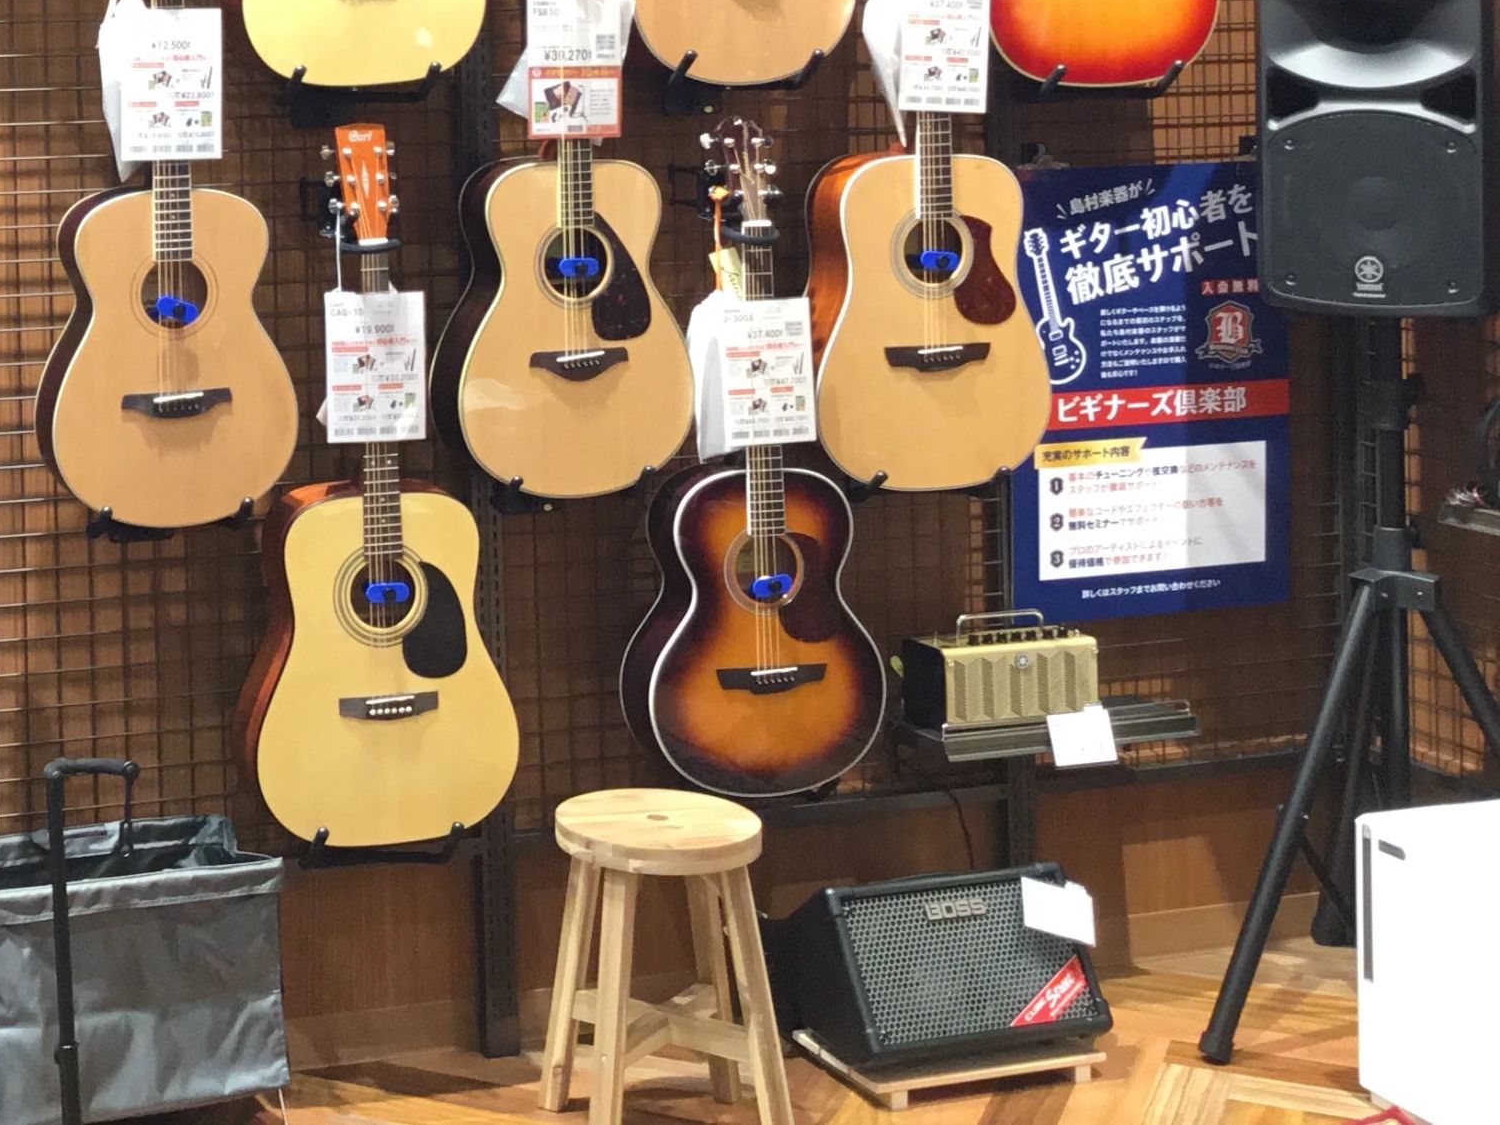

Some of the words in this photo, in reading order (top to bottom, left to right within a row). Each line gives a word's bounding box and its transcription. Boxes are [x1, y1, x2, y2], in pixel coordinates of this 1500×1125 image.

[1069, 180, 1143, 215] 島村楽器が
[1059, 183, 1253, 259] ギター初心者を
[1065, 220, 1258, 305] 徹底サポート
[1057, 386, 1247, 423] ビギナーズ倶楽部
[1041, 445, 1131, 463] 充実のサポート内容
[924, 898, 986, 920] BOSS
